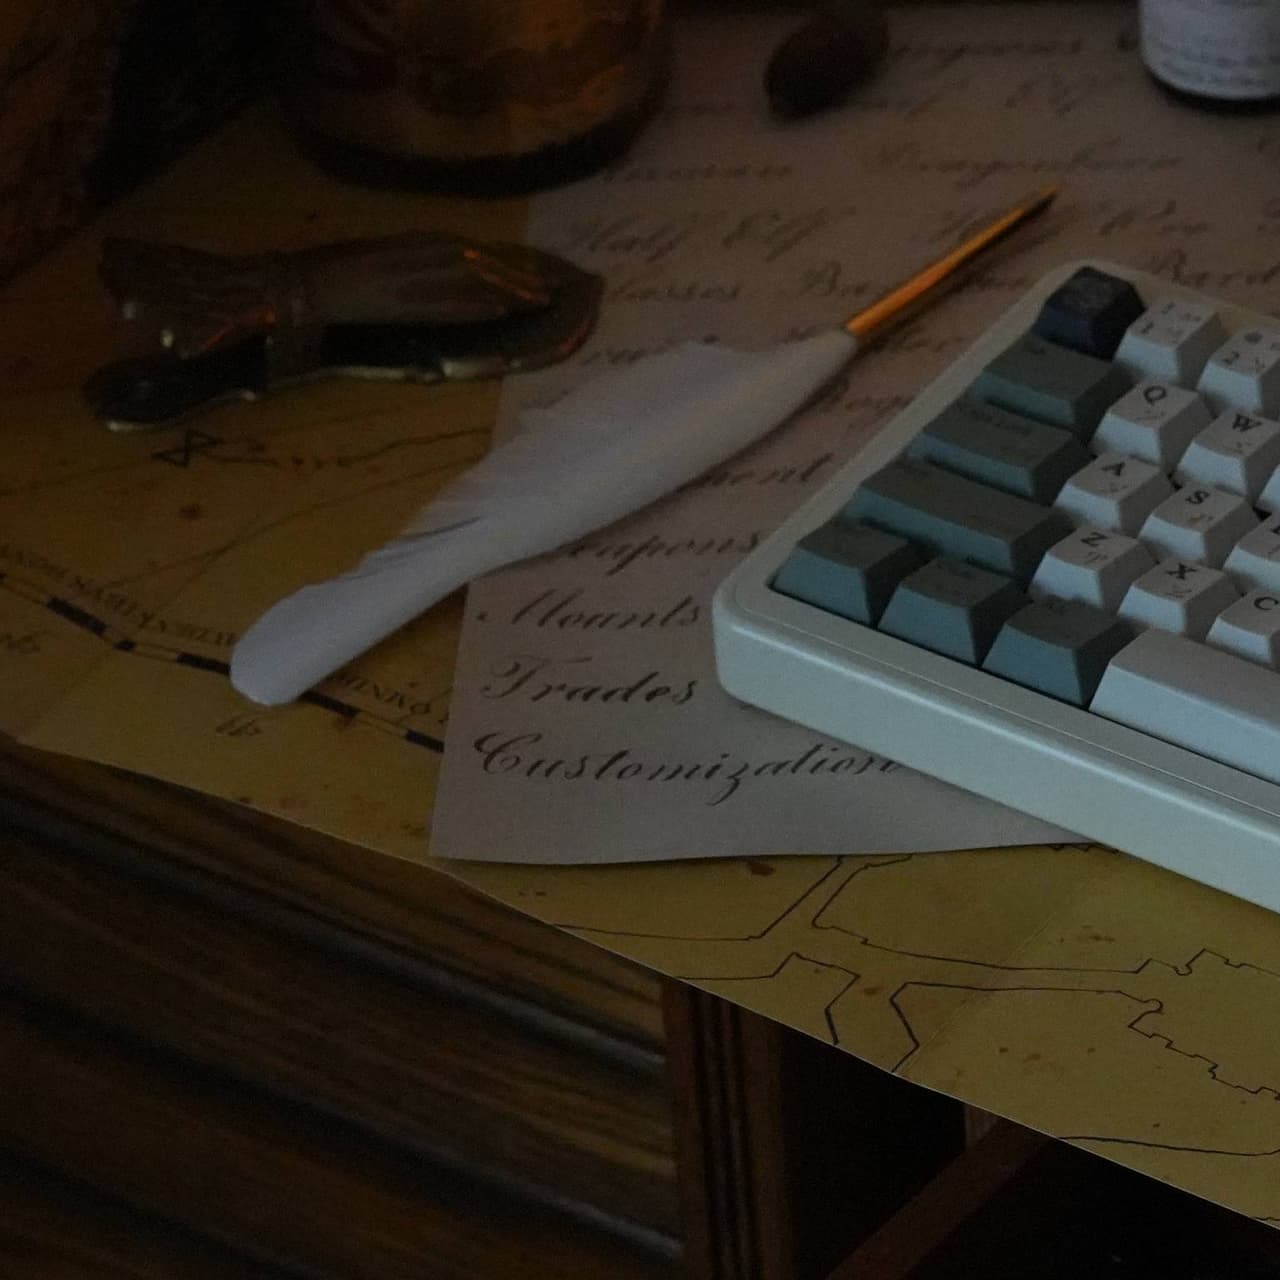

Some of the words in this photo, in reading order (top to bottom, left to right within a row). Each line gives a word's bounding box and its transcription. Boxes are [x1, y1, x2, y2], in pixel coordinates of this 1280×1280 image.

[1143, 385, 1167, 405] Q
[1231, 413, 1261, 433] W
[1102, 461, 1126, 477] A
[1185, 490, 1209, 505] S
[1081, 531, 1109, 547] Z
[1167, 563, 1197, 580] X
[1253, 596, 1280, 612] C
[480, 654, 697, 706] Trades
[472, 730, 906, 807] Customization
